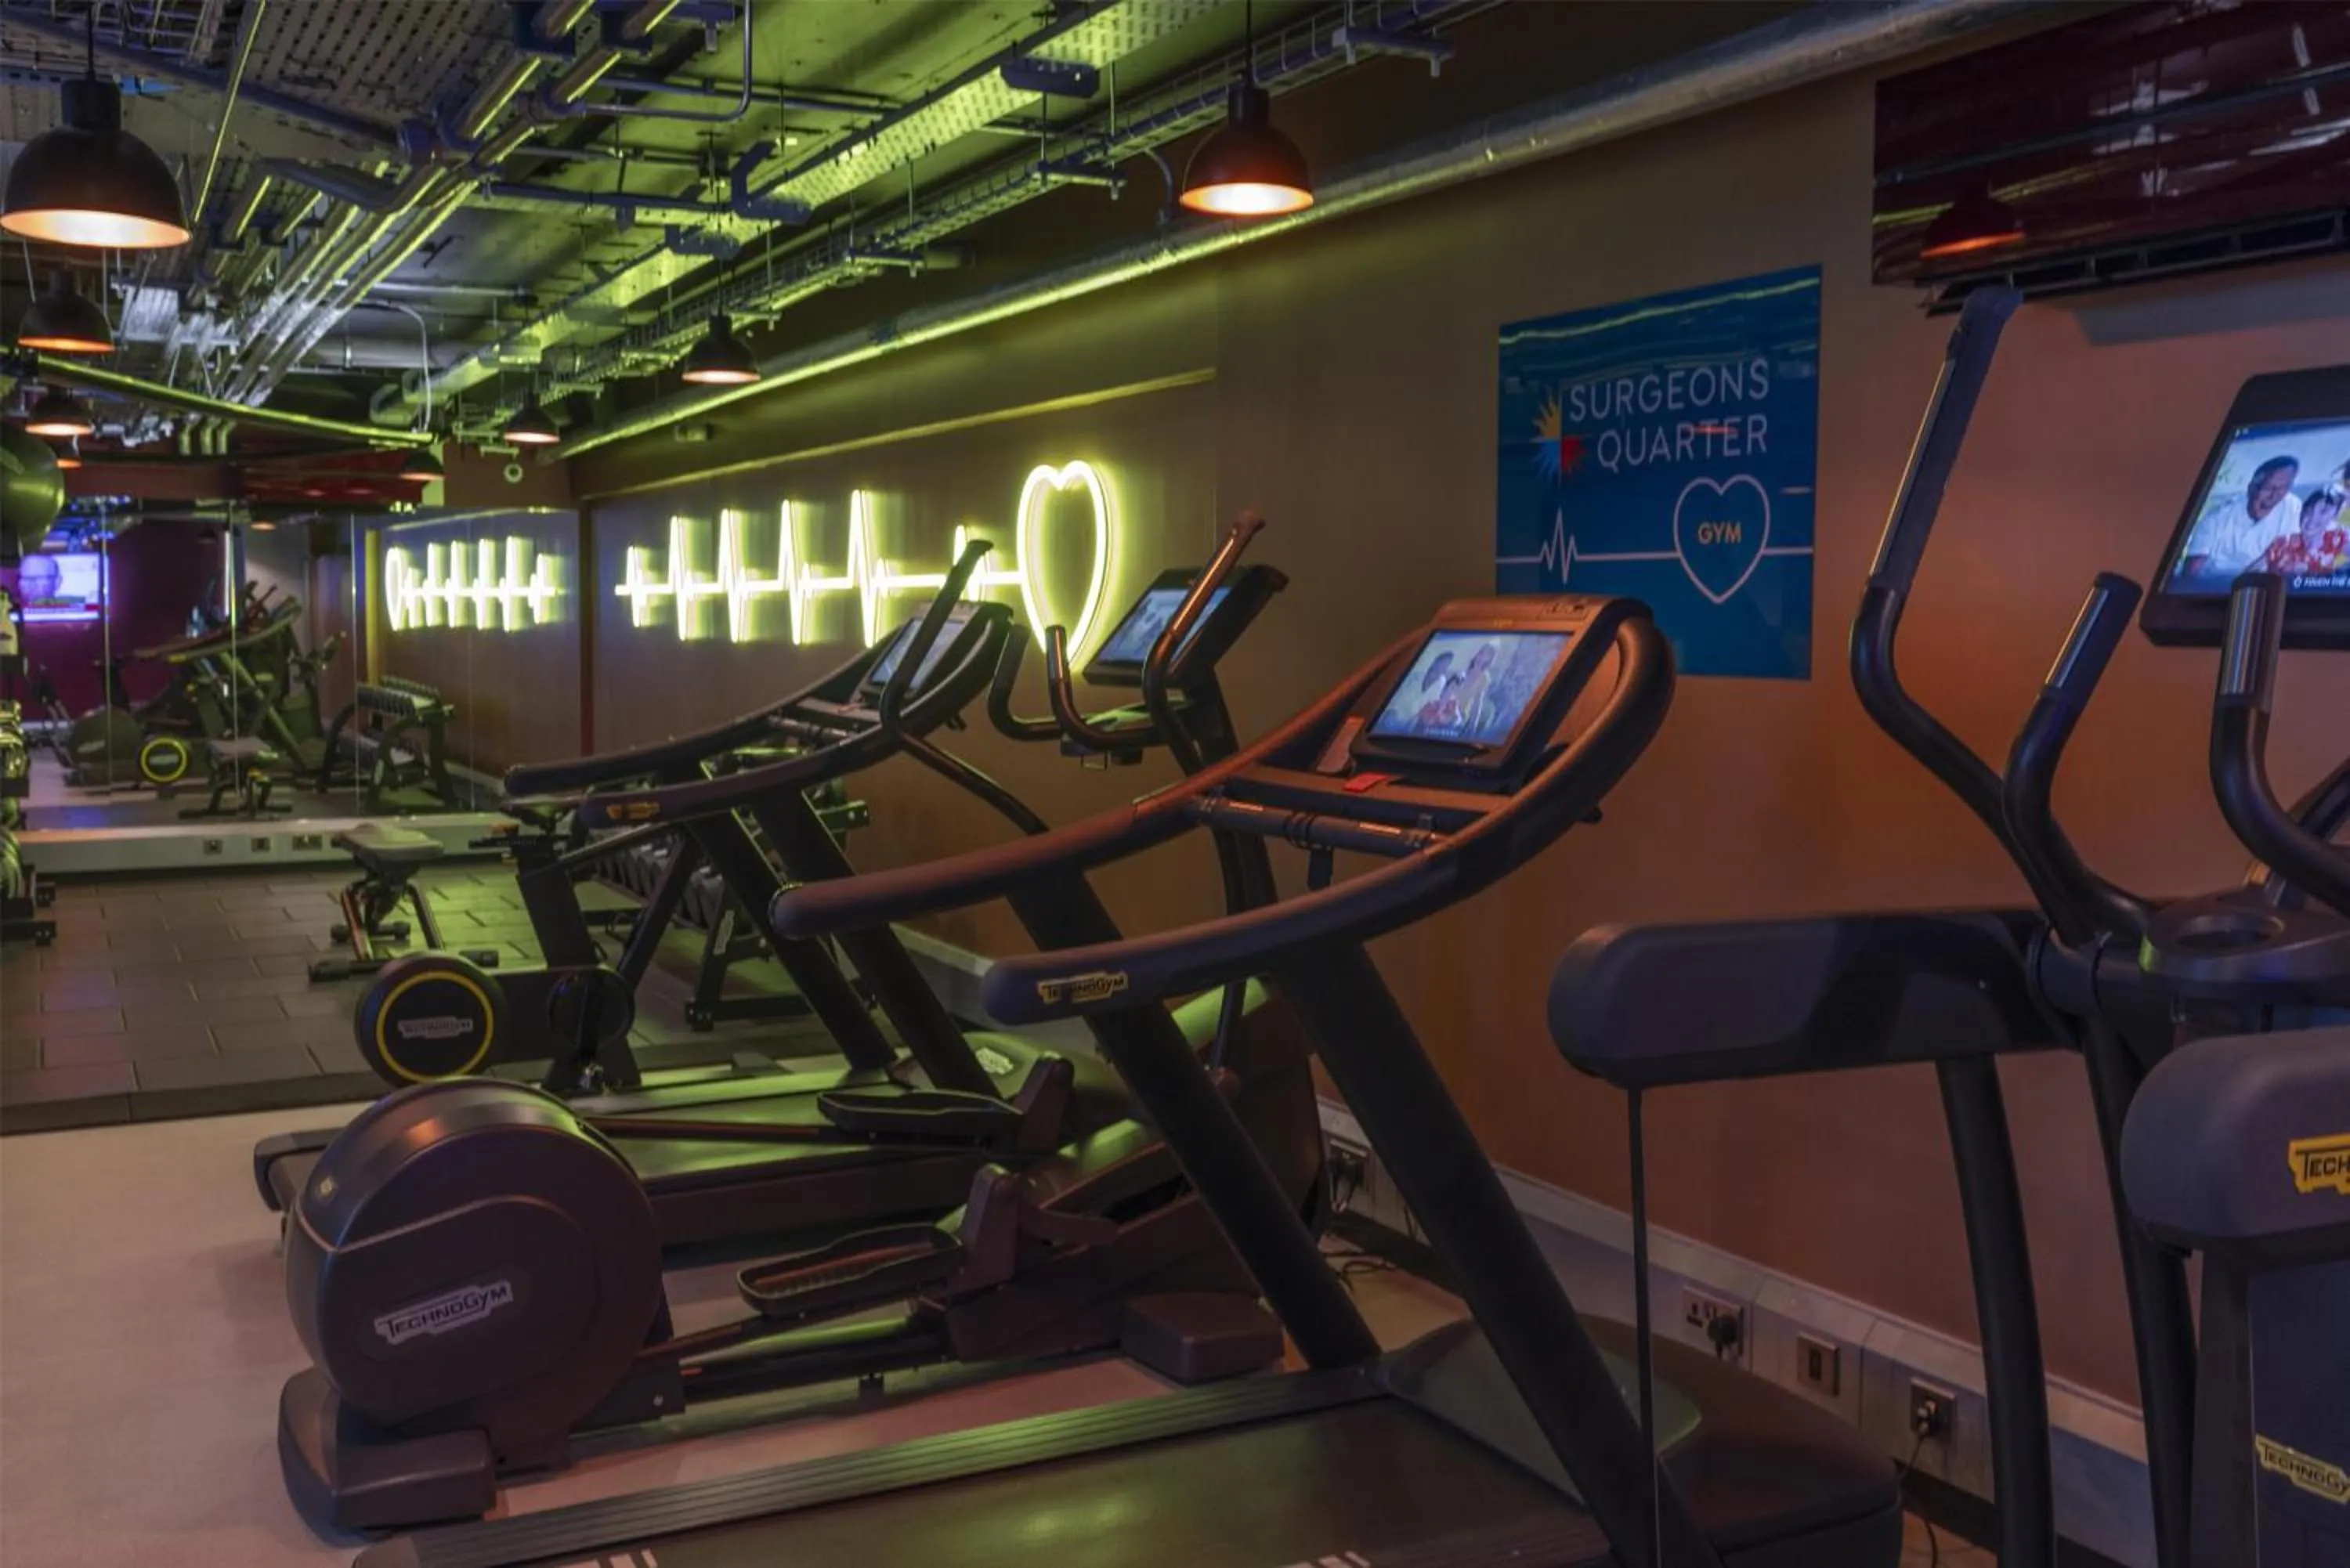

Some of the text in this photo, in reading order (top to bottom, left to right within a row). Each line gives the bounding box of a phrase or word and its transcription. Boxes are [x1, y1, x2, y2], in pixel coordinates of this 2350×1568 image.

[1569, 358, 1770, 422] SURGEONS
[1597, 414, 1768, 474] QUARTER
[1697, 520, 1742, 545] GYM
[1040, 974, 1125, 1000] TEHNOGYM
